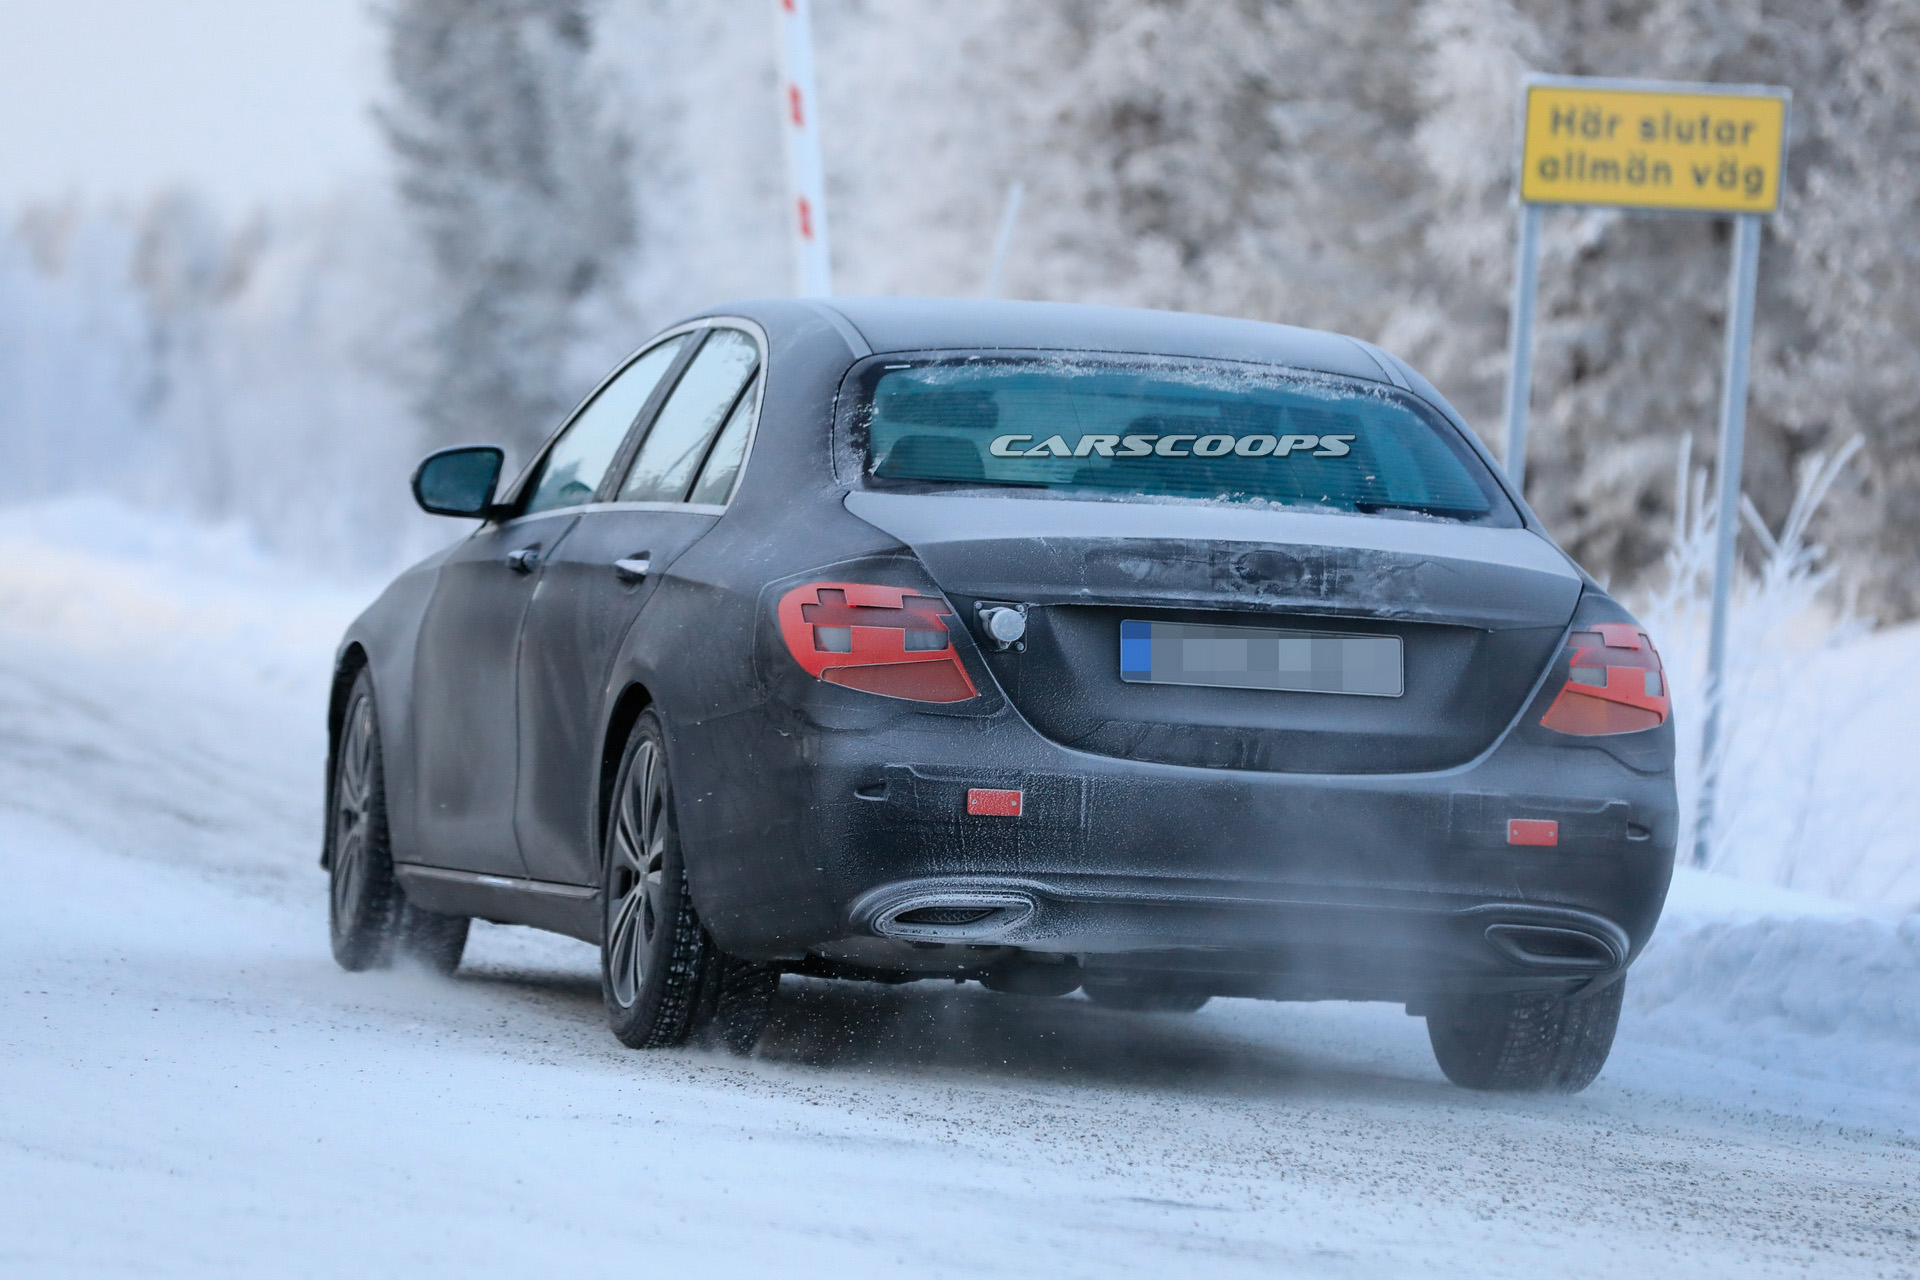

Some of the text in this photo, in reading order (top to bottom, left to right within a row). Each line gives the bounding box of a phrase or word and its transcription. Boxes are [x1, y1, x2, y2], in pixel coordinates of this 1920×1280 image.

[1551, 104, 1756, 145] Här slutar
[1538, 151, 1765, 199] allmän väg
